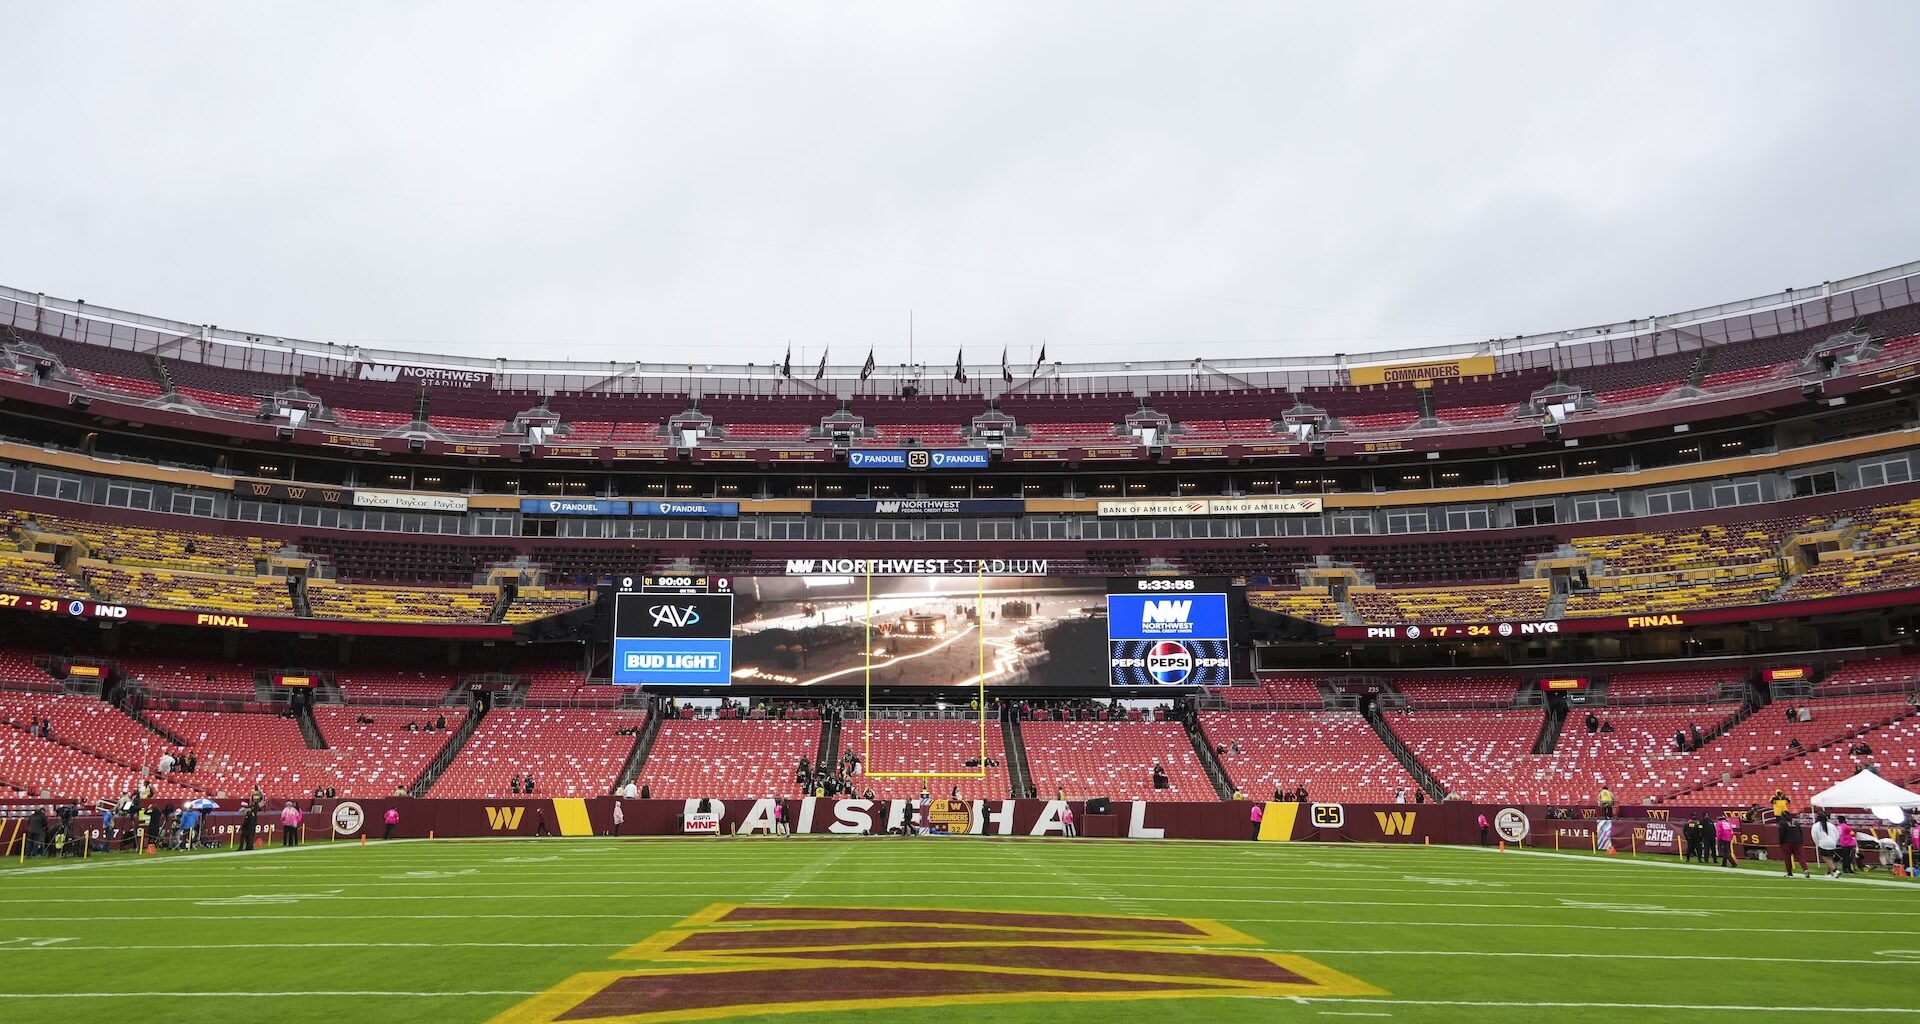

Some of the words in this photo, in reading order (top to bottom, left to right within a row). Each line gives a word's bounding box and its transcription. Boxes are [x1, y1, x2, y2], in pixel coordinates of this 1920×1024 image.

[359, 363, 402, 382] NW
[404, 367, 489, 382] NORTHWEST
[1384, 366, 1460, 382] COMMANDERS
[1177, 448, 1187, 456] 22
[864, 455, 905, 463] FANDUEL
[912, 454, 925, 464] 25
[946, 455, 986, 463] FANDUEL
[357, 495, 390, 505] Paycor
[396, 497, 429, 507] Paycor
[434, 499, 466, 509] Paycor
[562, 503, 598, 511] FANDUEL
[672, 503, 707, 511] FANDUEL
[1254, 503, 1296, 511] AMERICA
[786, 559, 816, 573] NW
[822, 559, 948, 573] NORTHWEST
[953, 559, 1047, 573] STADIUM
[623, 577, 633, 587] 0
[645, 578, 653, 586] Q1
[659, 577, 692, 586] 90:00
[718, 578, 728, 588] 0
[1138, 580, 1195, 590] 5:33:58
[0, 593, 20, 606] 27
[40, 599, 59, 611] 31
[95, 605, 127, 618] IND
[197, 614, 249, 628] FINAL
[1142, 600, 1193, 623] NW
[1367, 627, 1395, 638] PHI
[1430, 626, 1448, 637] 17
[1467, 625, 1491, 636] 34
[1520, 621, 1559, 634] NYG
[1628, 613, 1684, 628] FINAL
[627, 655, 665, 669] BUD
[666, 655, 718, 669] LIGHT
[1112, 658, 1145, 667] PEPSI
[1150, 658, 1189, 667] PEPSI
[1195, 658, 1229, 667] PEPSI
[972, 799, 1166, 839] HAL
[1317, 806, 1339, 823] 25
[212, 824, 244, 834] 1987
[686, 821, 718, 830] MNF
[1560, 828, 1589, 838] FIVE
[1645, 829, 1673, 842] CATCH
